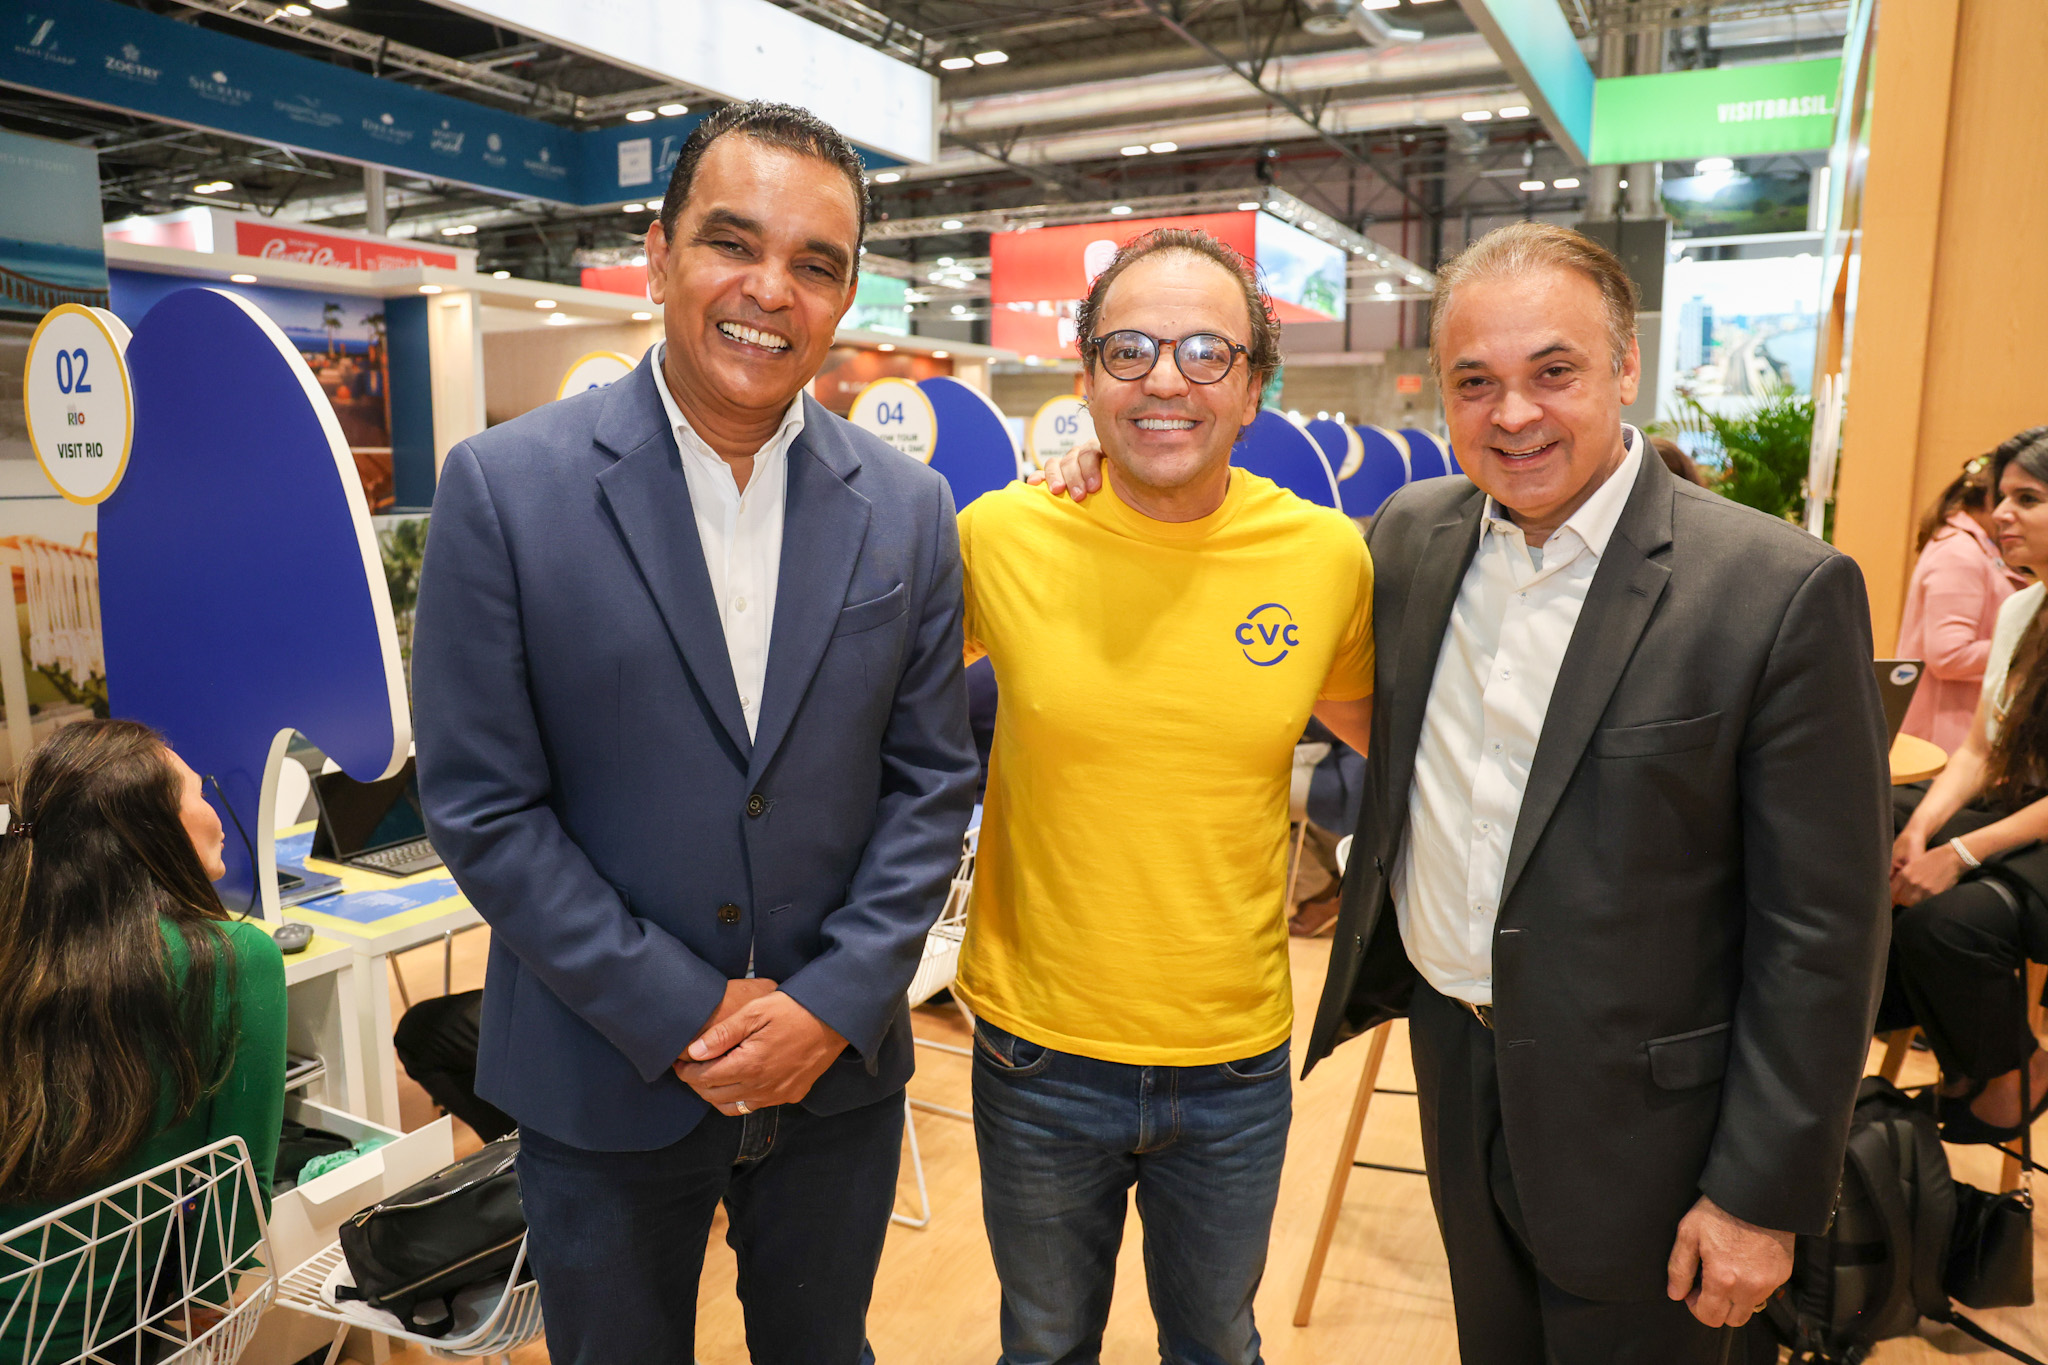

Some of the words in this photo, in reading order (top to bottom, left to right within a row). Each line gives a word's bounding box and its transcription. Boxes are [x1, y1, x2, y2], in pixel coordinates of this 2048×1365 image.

[56, 347, 92, 395] 02
[67, 412, 86, 426] RIO
[877, 401, 905, 425] 04
[1054, 414, 1079, 435] 05
[57, 442, 83, 459] VISIT
[85, 442, 104, 458] RIO
[1235, 622, 1300, 647] CVC
